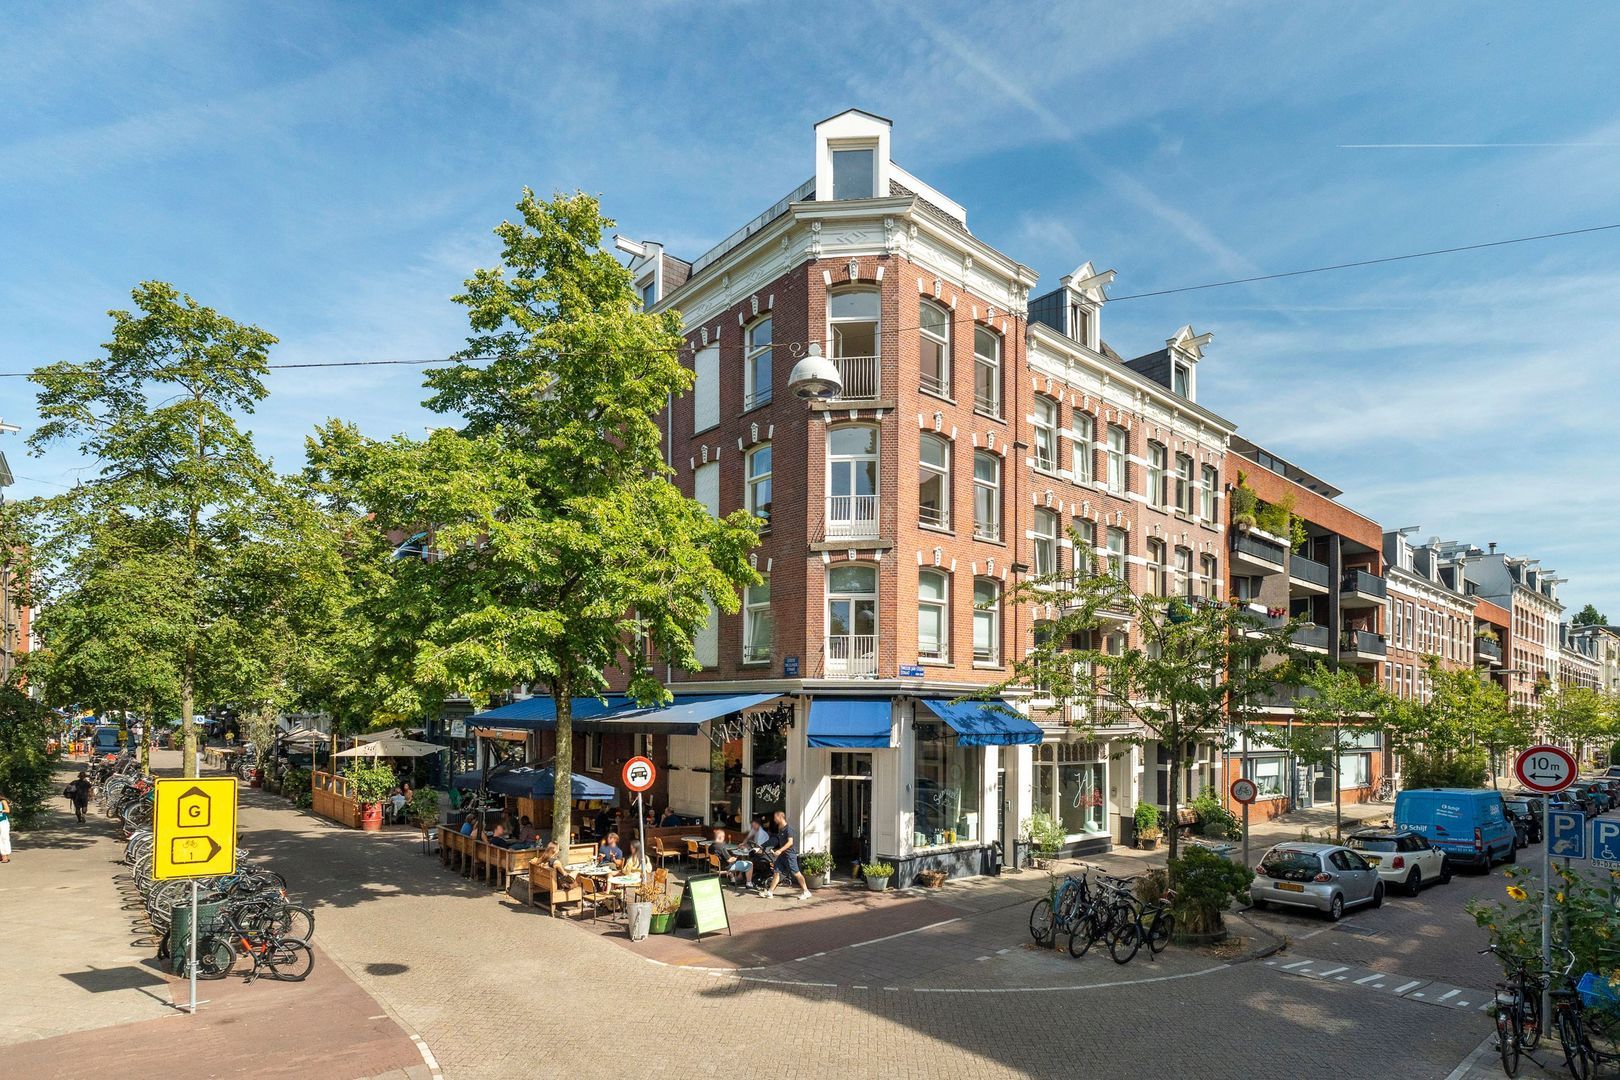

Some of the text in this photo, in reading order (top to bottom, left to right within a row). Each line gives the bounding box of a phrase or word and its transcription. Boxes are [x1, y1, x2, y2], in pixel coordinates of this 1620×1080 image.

[189, 805, 201, 818] G
[1408, 824, 1428, 832] Schijf
[1554, 815, 1576, 837] P
[1600, 822, 1620, 843] P
